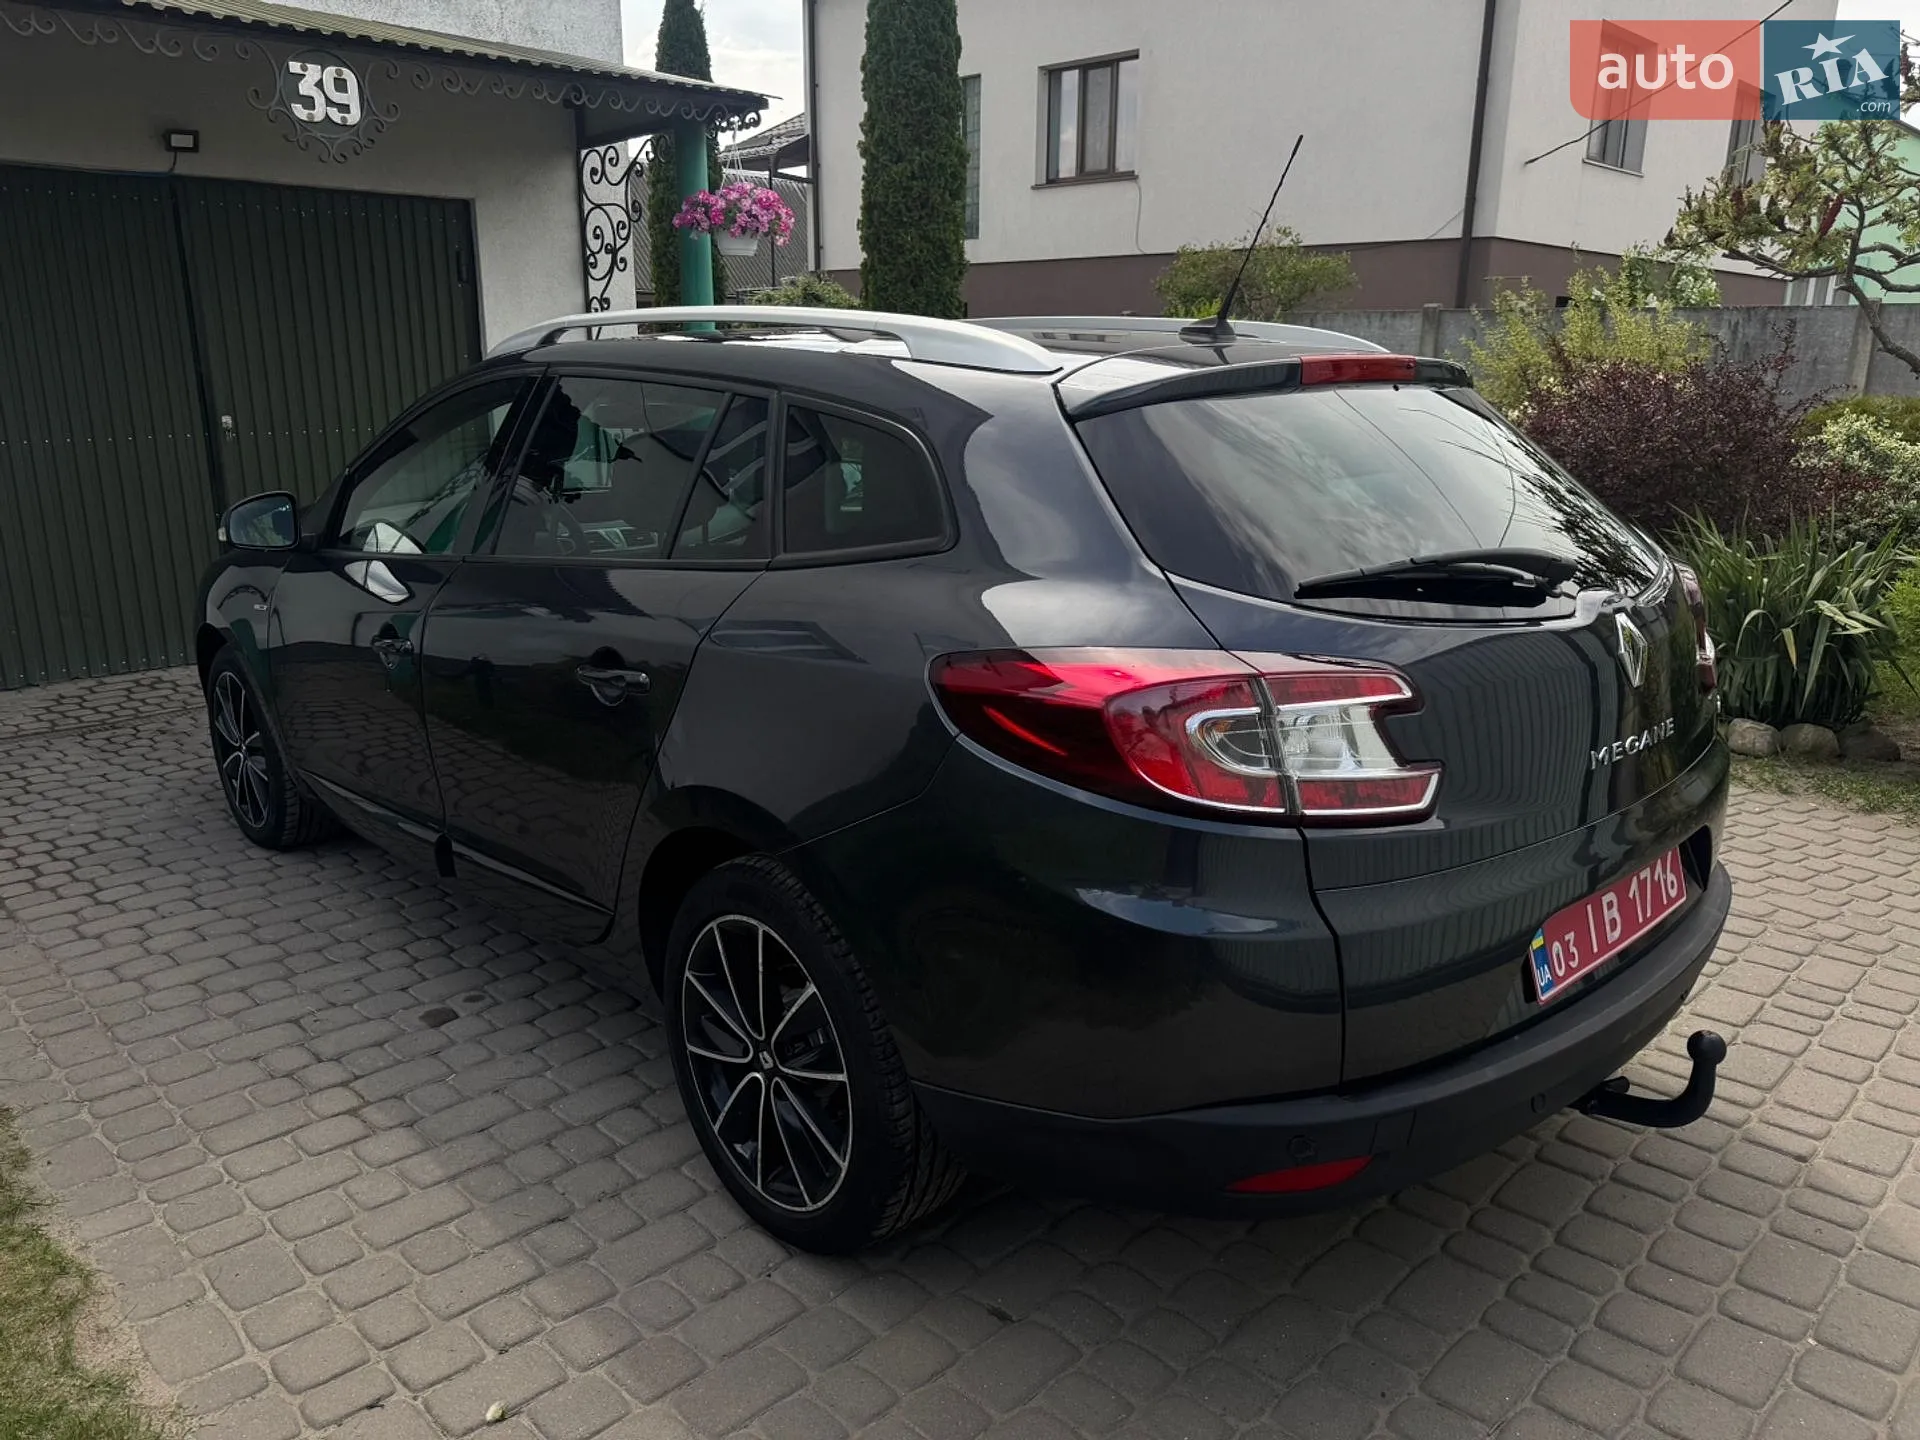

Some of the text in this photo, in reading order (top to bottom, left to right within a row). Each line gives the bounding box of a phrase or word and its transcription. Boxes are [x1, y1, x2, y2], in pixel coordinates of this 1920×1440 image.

[288, 61, 361, 126] 39
[1590, 717, 1674, 770] MEGANE
[1551, 851, 1678, 977] 03 IB 1716
[1537, 964, 1552, 987] UA
